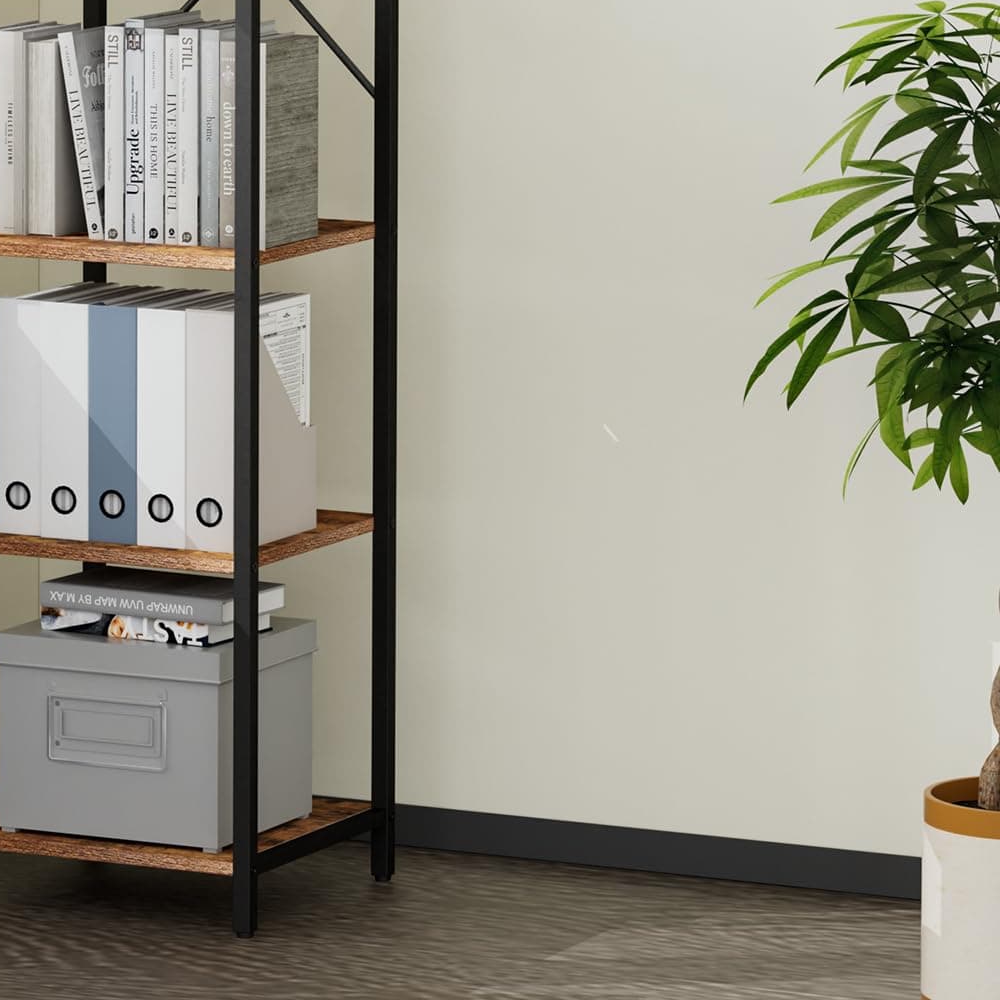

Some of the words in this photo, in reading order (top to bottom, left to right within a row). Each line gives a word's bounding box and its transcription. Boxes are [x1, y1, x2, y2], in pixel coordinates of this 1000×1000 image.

[107, 34, 119, 68] STILL
[181, 37, 193, 70] STILL
[68, 89, 83, 124] LIVE
[149, 103, 158, 130] THIS
[167, 93, 177, 128] LIVE
[223, 101, 236, 140] down
[149, 132, 158, 143] IS
[206, 115, 216, 143] home
[126, 128, 144, 195] Upgrade
[149, 144, 158, 179] HOME
[224, 142, 235, 156] to
[74, 127, 97, 208] BEAUTIFUL
[167, 131, 177, 215] BEAUTIFUL
[223, 159, 236, 196] earth
[78, 593, 92, 605] BY
[94, 595, 118, 608] MAP
[119, 598, 144, 611] UVW
[146, 600, 193, 616] UNWRAP
